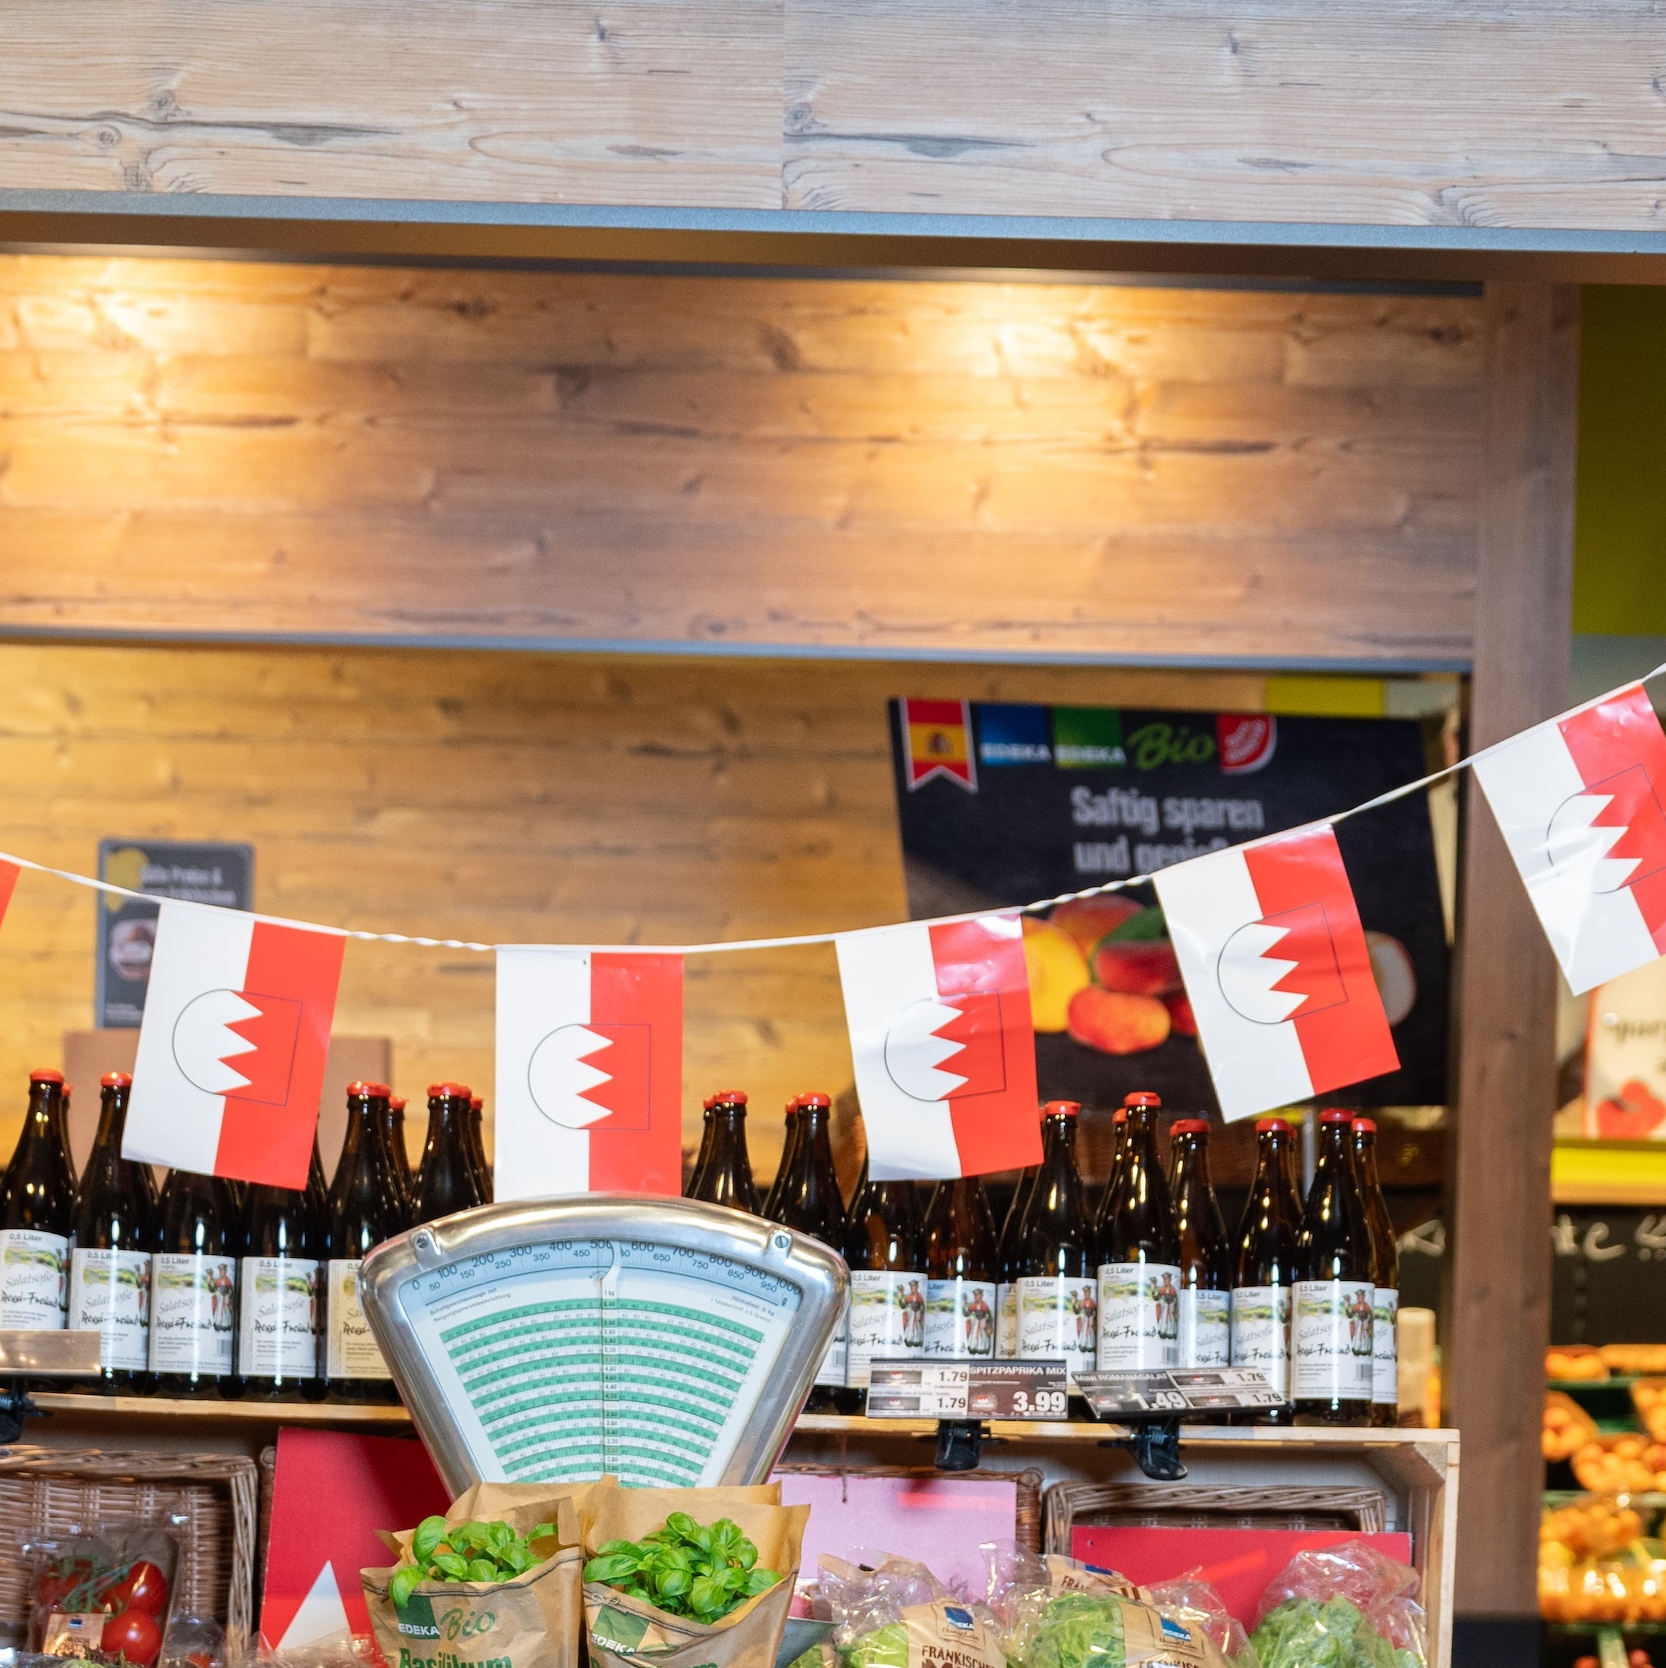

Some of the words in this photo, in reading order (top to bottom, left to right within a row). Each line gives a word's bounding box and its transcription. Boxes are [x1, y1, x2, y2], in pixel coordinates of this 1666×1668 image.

[1070, 785, 1160, 836] Saftig
[1163, 797, 1265, 834] sparen
[412, 1279, 420, 1290] 0
[437, 1265, 458, 1279] 100
[471, 1253, 494, 1268] 200
[509, 1245, 533, 1258] 300
[549, 1240, 573, 1251] 400
[429, 1281, 440, 1291] 50
[459, 1269, 475, 1279] 150
[495, 1259, 512, 1270] 250
[533, 1253, 551, 1262] 350
[573, 1249, 590, 1258] 450
[653, 1253, 670, 1262] 650
[692, 1259, 709, 1270] 750
[727, 1269, 745, 1280] 850
[760, 1281, 778, 1293] 950
[672, 1246, 694, 1258] 700
[709, 1253, 733, 1268] 800
[744, 1265, 768, 1280] 900
[776, 1278, 801, 1295] 1000
[938, 1371, 968, 1382] 1.79
[969, 1366, 1043, 1375] SPITZPAPRIKA
[1045, 1366, 1066, 1375] MIX
[1236, 1371, 1266, 1382] 1.79
[937, 1398, 966, 1409] 1.79
[1013, 1391, 1066, 1412] 3.99
[1252, 1393, 1282, 1403] 1.79
[398, 1622, 440, 1636] EDEKA
[440, 1608, 497, 1641] Bio
